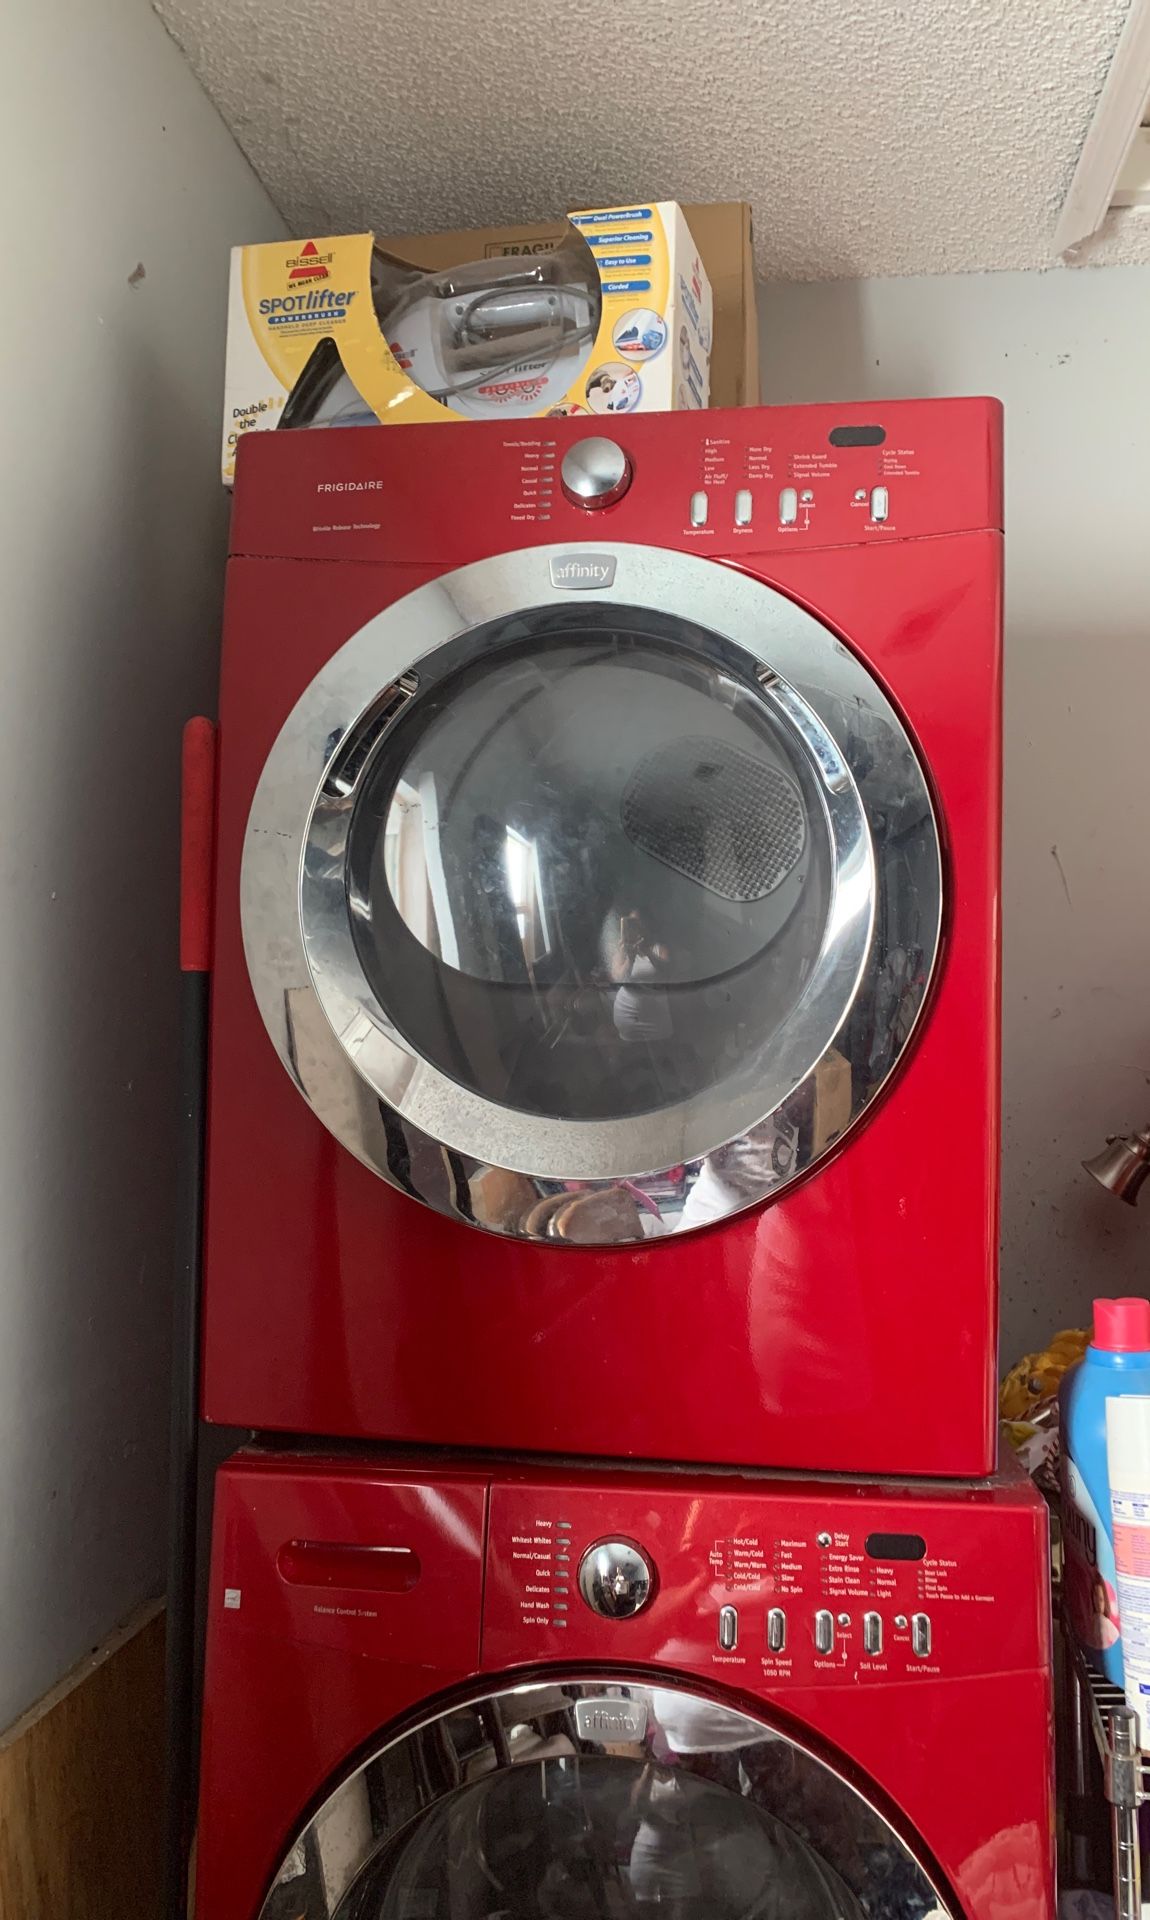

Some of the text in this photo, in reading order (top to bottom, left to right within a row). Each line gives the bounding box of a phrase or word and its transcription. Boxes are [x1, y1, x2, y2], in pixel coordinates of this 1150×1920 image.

[623, 233, 649, 241] Cleaning
[259, 289, 356, 315] SPOTlifter
[233, 403, 267, 418] Double
[240, 419, 256, 429] the
[317, 480, 383, 493] FRIGIDAIRE
[733, 527, 753, 535] Dryness
[778, 526, 798, 534] Options
[557, 562, 609, 581] affinity
[536, 1520, 552, 1529] Heavy
[512, 1536, 532, 1544] Whitest
[834, 1532, 849, 1540] Delay
[733, 1538, 758, 1546] Hot/Cold
[781, 1539, 807, 1547] Maximum
[513, 1552, 551, 1560] Normal/Casual
[734, 1549, 764, 1558] Warm/Cold
[781, 1551, 792, 1559] Fast
[829, 1553, 847, 1562] Energy
[709, 1558, 724, 1566] Temp
[734, 1561, 767, 1569] Warm/Warm
[781, 1562, 802, 1570] Medium
[923, 1559, 938, 1567] Cycle
[536, 1569, 551, 1577] Quick
[844, 1565, 859, 1573] Rinse
[876, 1566, 894, 1575] Heavy
[733, 1572, 760, 1580] Cold/Cold
[829, 1576, 861, 1584] Stain Clean
[877, 1578, 897, 1586] Normal
[526, 1585, 550, 1593] Delicates
[733, 1584, 760, 1592] Cold/Cold
[790, 1586, 803, 1594] Spin
[829, 1587, 868, 1596] Signal Volume
[877, 1590, 892, 1599] Light
[521, 1601, 534, 1609] Hand
[313, 1605, 377, 1617] Balance Control System
[536, 1617, 549, 1625] Only
[837, 1631, 853, 1639] Select
[712, 1655, 746, 1665] Temperature
[761, 1658, 793, 1667] Spin Speed
[814, 1660, 836, 1669] Options
[860, 1661, 888, 1671] Soil Level
[906, 1664, 940, 1673] Start/Pause
[584, 1710, 639, 1731] affinity
